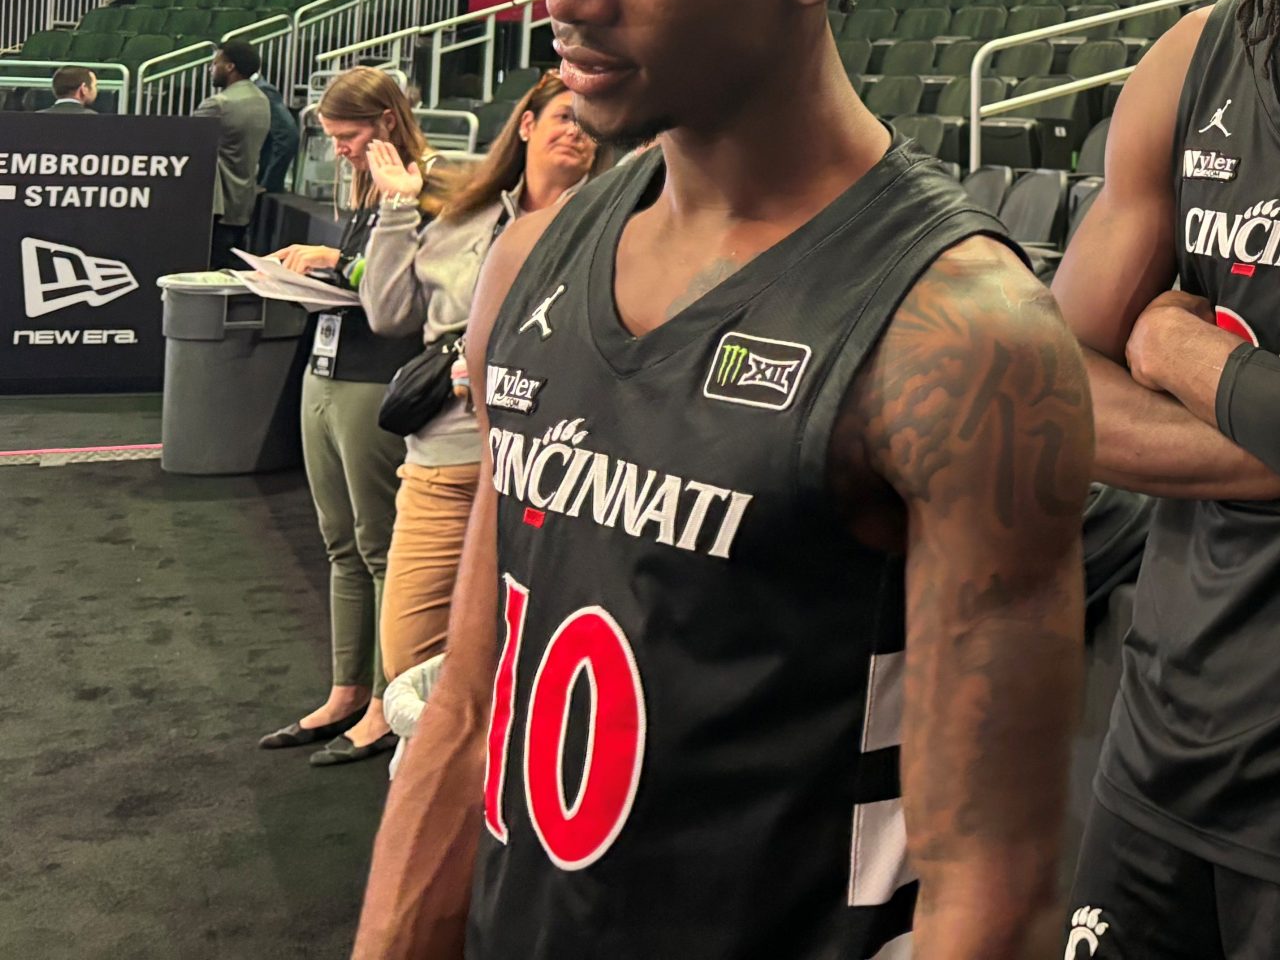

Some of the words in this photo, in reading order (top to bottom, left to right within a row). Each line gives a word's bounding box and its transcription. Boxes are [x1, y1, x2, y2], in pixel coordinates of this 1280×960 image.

[0, 152, 190, 177] EMBROIDERY
[23, 185, 150, 209] STATION
[488, 420, 754, 559] CINCINNATI
[483, 572, 648, 872] 10
